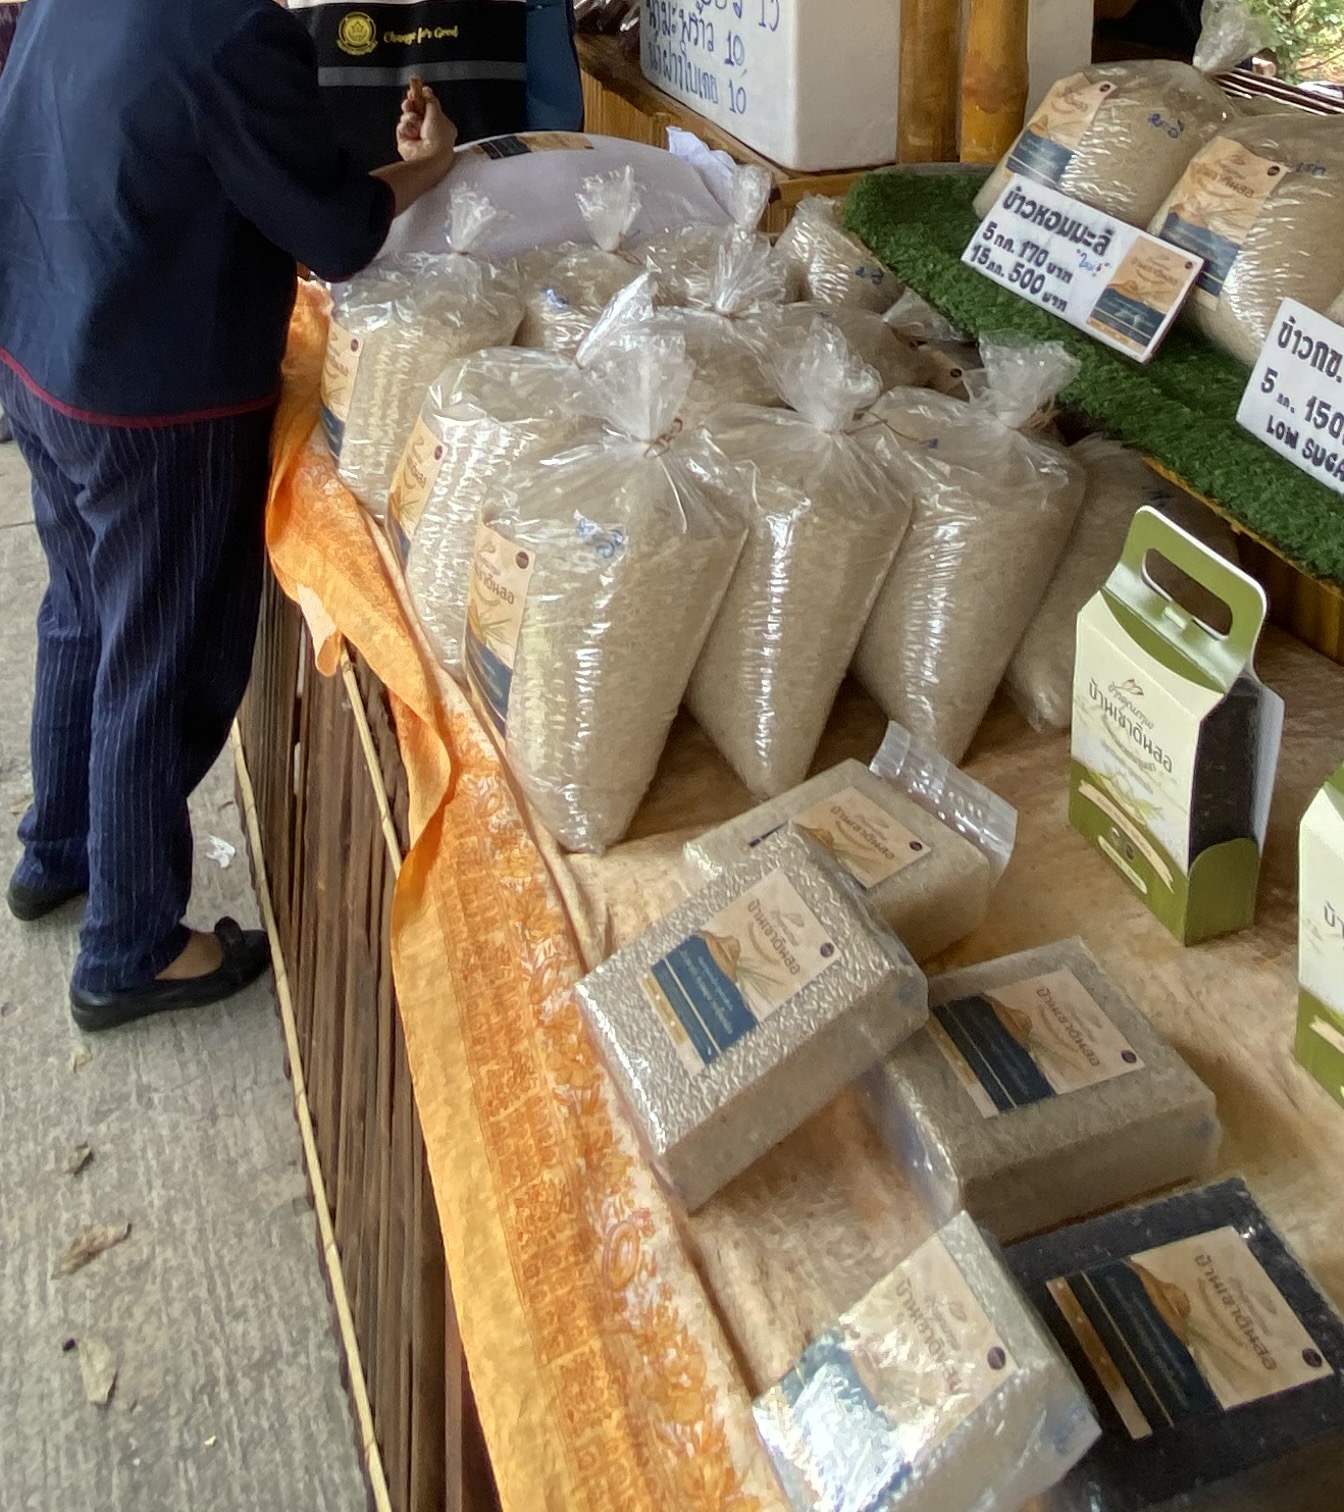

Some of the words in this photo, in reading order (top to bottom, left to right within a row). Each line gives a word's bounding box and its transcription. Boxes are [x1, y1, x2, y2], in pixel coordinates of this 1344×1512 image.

[724, 30, 745, 67] 10
[728, 79, 747, 115] 10
[1002, 186, 1115, 257] ข้าวหอมมะลิ
[1018, 240, 1048, 268] 170
[1008, 261, 1047, 295] 500
[1266, 414, 1300, 451] LOW
